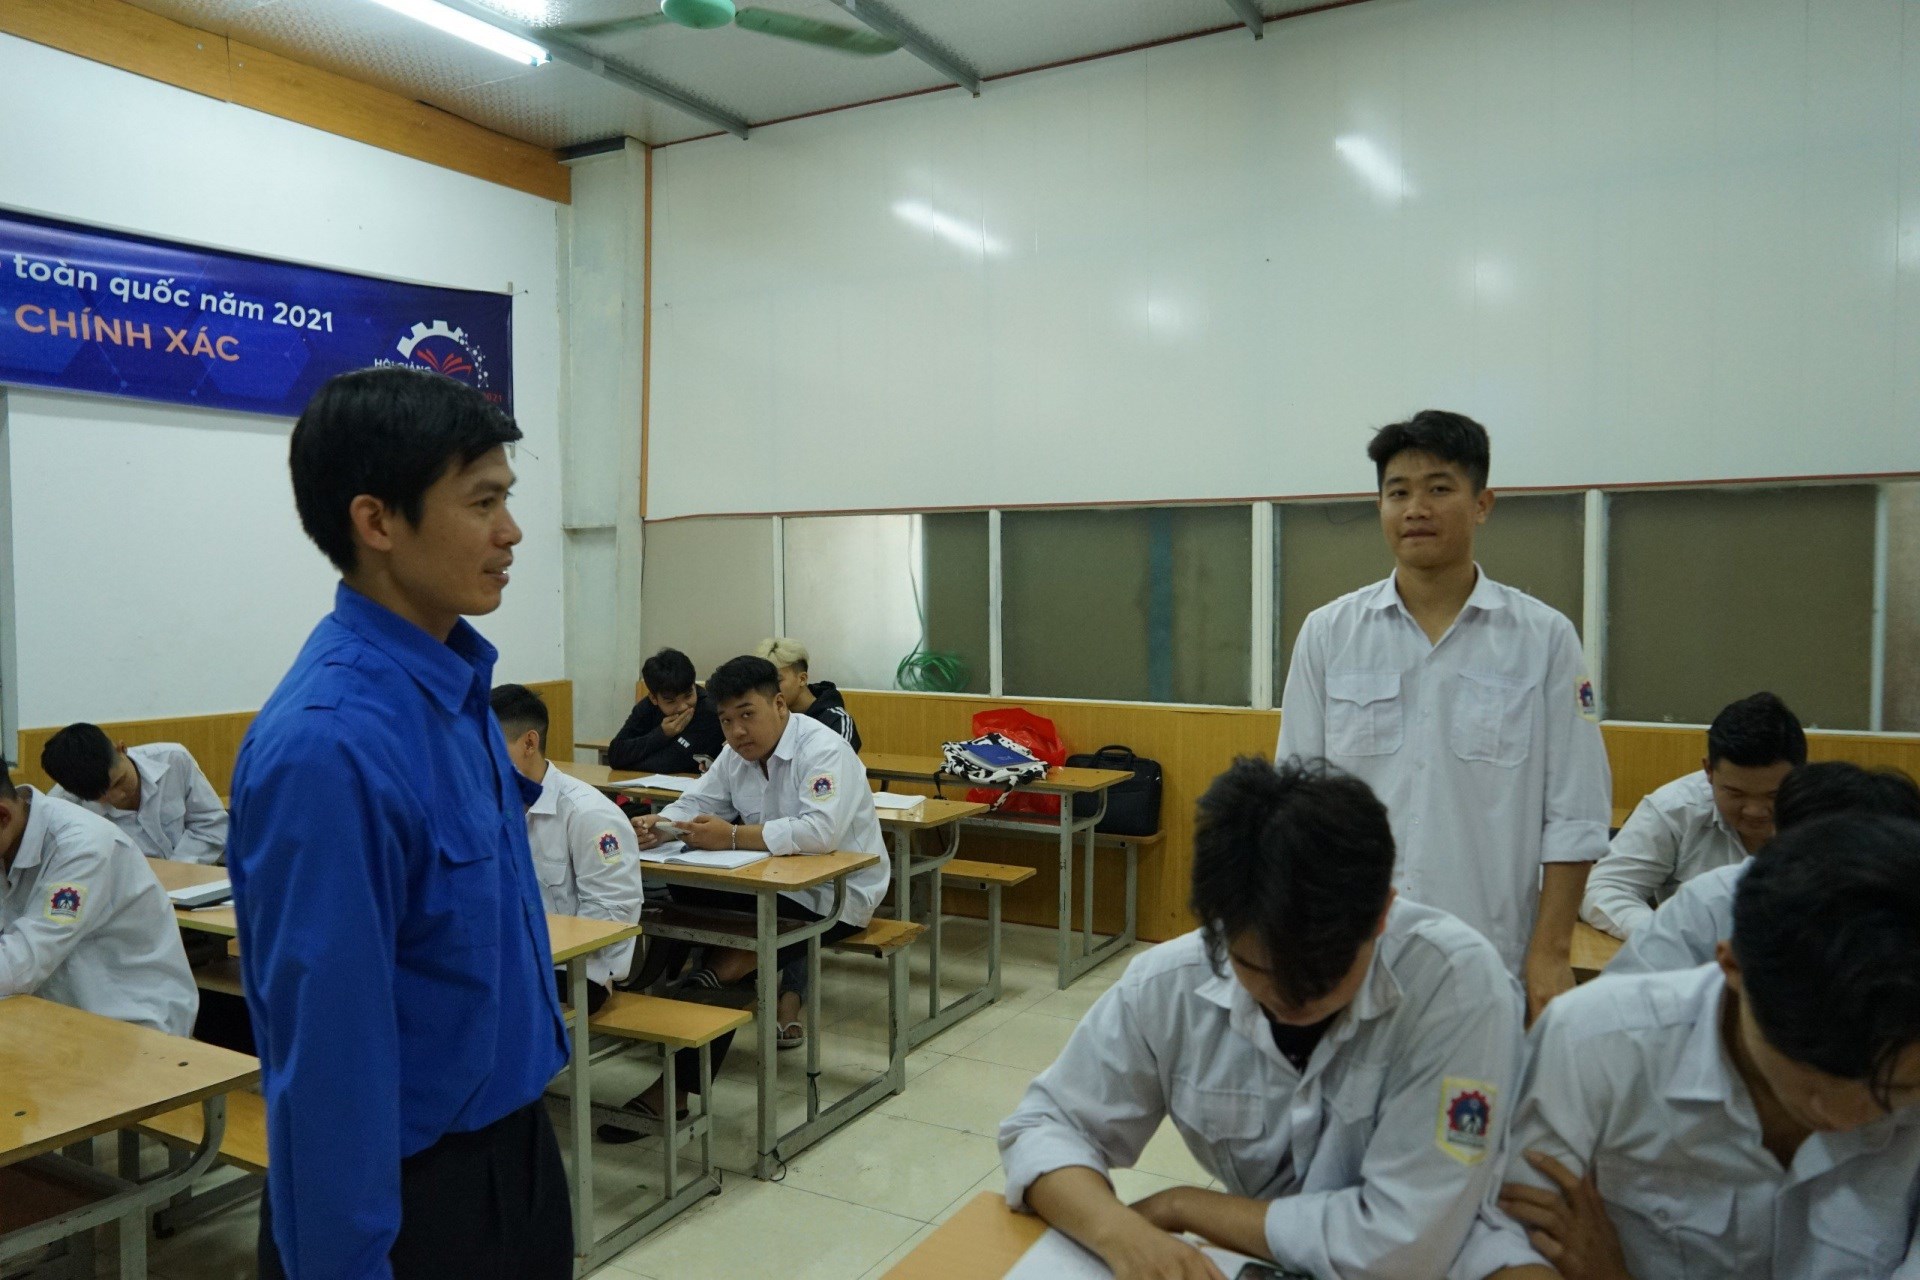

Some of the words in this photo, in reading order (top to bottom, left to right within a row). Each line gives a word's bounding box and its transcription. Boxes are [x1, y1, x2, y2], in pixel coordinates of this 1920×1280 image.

[13, 253, 98, 291] toàn
[109, 277, 190, 308] quốc
[201, 291, 264, 321] năm
[272, 301, 333, 333] 2021
[15, 303, 152, 350] CHÍNH
[164, 326, 240, 362] XÁC
